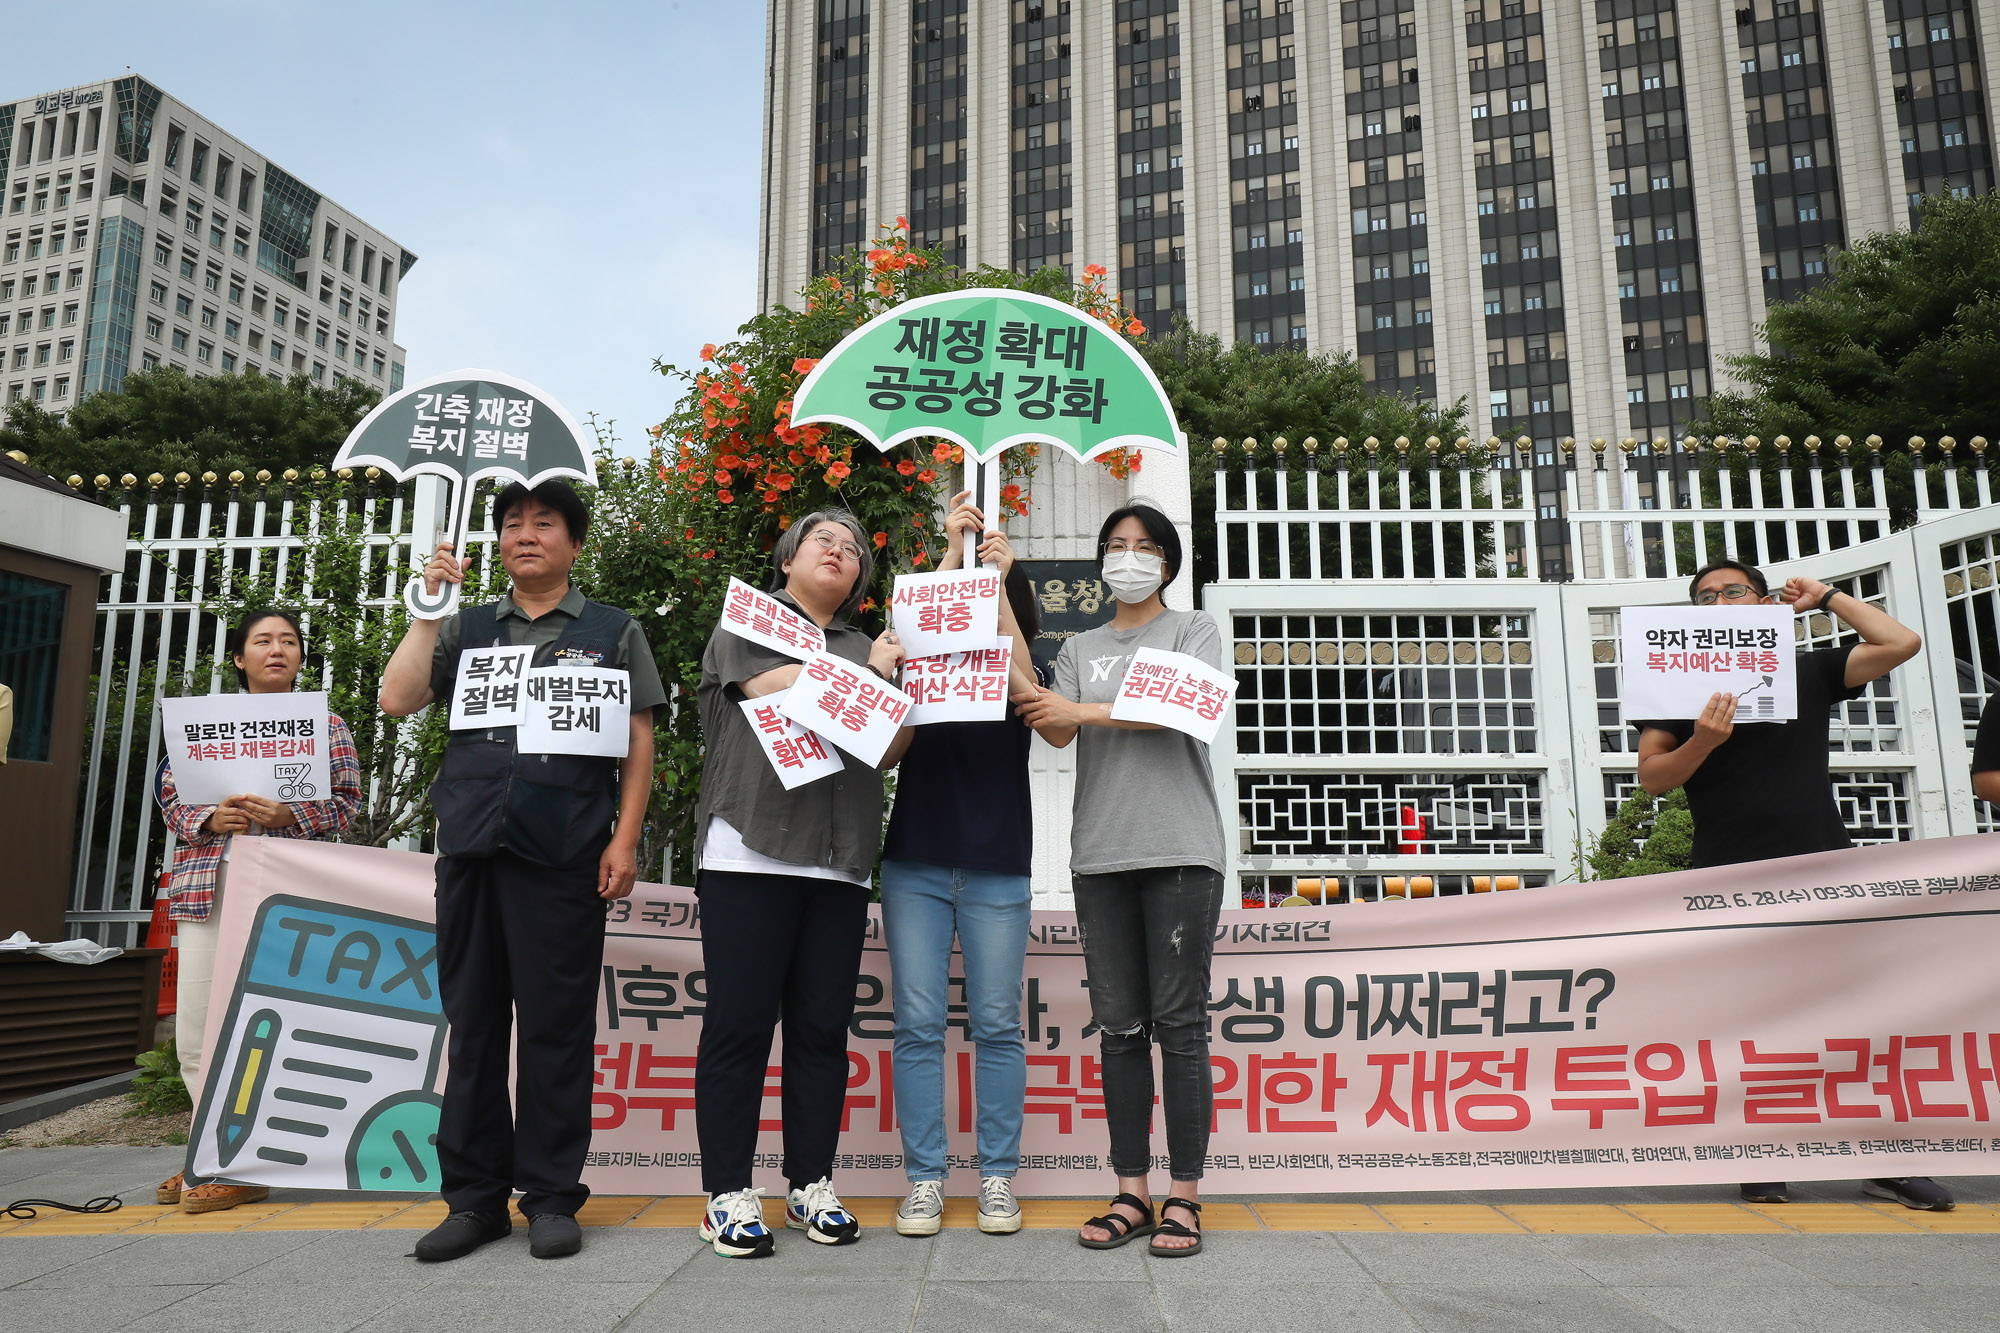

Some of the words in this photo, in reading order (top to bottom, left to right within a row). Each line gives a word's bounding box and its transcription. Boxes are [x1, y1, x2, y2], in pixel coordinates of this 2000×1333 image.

[34, 91, 73, 114] 외교부
[74, 90, 103, 105] MOFA
[893, 316, 986, 365] 재정
[995, 320, 1088, 372] 확대
[414, 393, 471, 424] 긴축
[475, 397, 534, 428] 재정
[865, 365, 1004, 417] 공공성
[1013, 374, 1109, 424] 강화
[408, 424, 466, 457] 복지
[472, 429, 530, 461] 절벽
[893, 576, 999, 608] 사회안전망
[1029, 578, 1117, 614] 울청
[730, 585, 824, 642] 생태보호
[917, 602, 973, 635] 확충
[1645, 628, 1689, 650] 약자
[1692, 627, 1779, 650] 권리보장
[465, 653, 526, 682] 복지
[1646, 651, 1733, 673] 복지예산
[1736, 650, 1780, 673] 확충
[526, 676, 628, 705] 재벌부자
[806, 657, 909, 725] 공공임대
[904, 676, 950, 705] 예산
[952, 675, 1007, 702] 삭감
[1123, 675, 1225, 721] 권리보장
[1131, 661, 1179, 684] 장애인,
[1181, 672, 1229, 703] 노동자
[461, 683, 519, 716] 절벽
[816, 690, 870, 733] 확충
[184, 721, 237, 742] 말로만
[240, 718, 315, 739] 건전재정
[547, 705, 601, 733] 감세
[187, 741, 237, 761] 계속된
[240, 738, 316, 759] 재벌감세
[772, 730, 829, 769] 확대
[278, 767, 298, 776] TAX
[1683, 893, 1732, 912] 2023.
[1734, 892, 1752, 908] 6.
[1812, 884, 1867, 901] 09:30
[1866, 878, 1922, 898] 광화문
[278, 916, 438, 1001] TAX
[1304, 967, 1616, 1041] 어쩌려고?
[1365, 1047, 1532, 1133] 재정
[1550, 1039, 1718, 1130] 투입
[1248, 1153, 1333, 1171] 빈곤사회연대,
[1631, 1145, 1691, 1163] 참여연대,
[1693, 1143, 1795, 1161] 함께살기연구소,
[1796, 1140, 1857, 1157] 한국노총,
[1859, 1137, 1986, 1154] 한국비정규노동센터,
